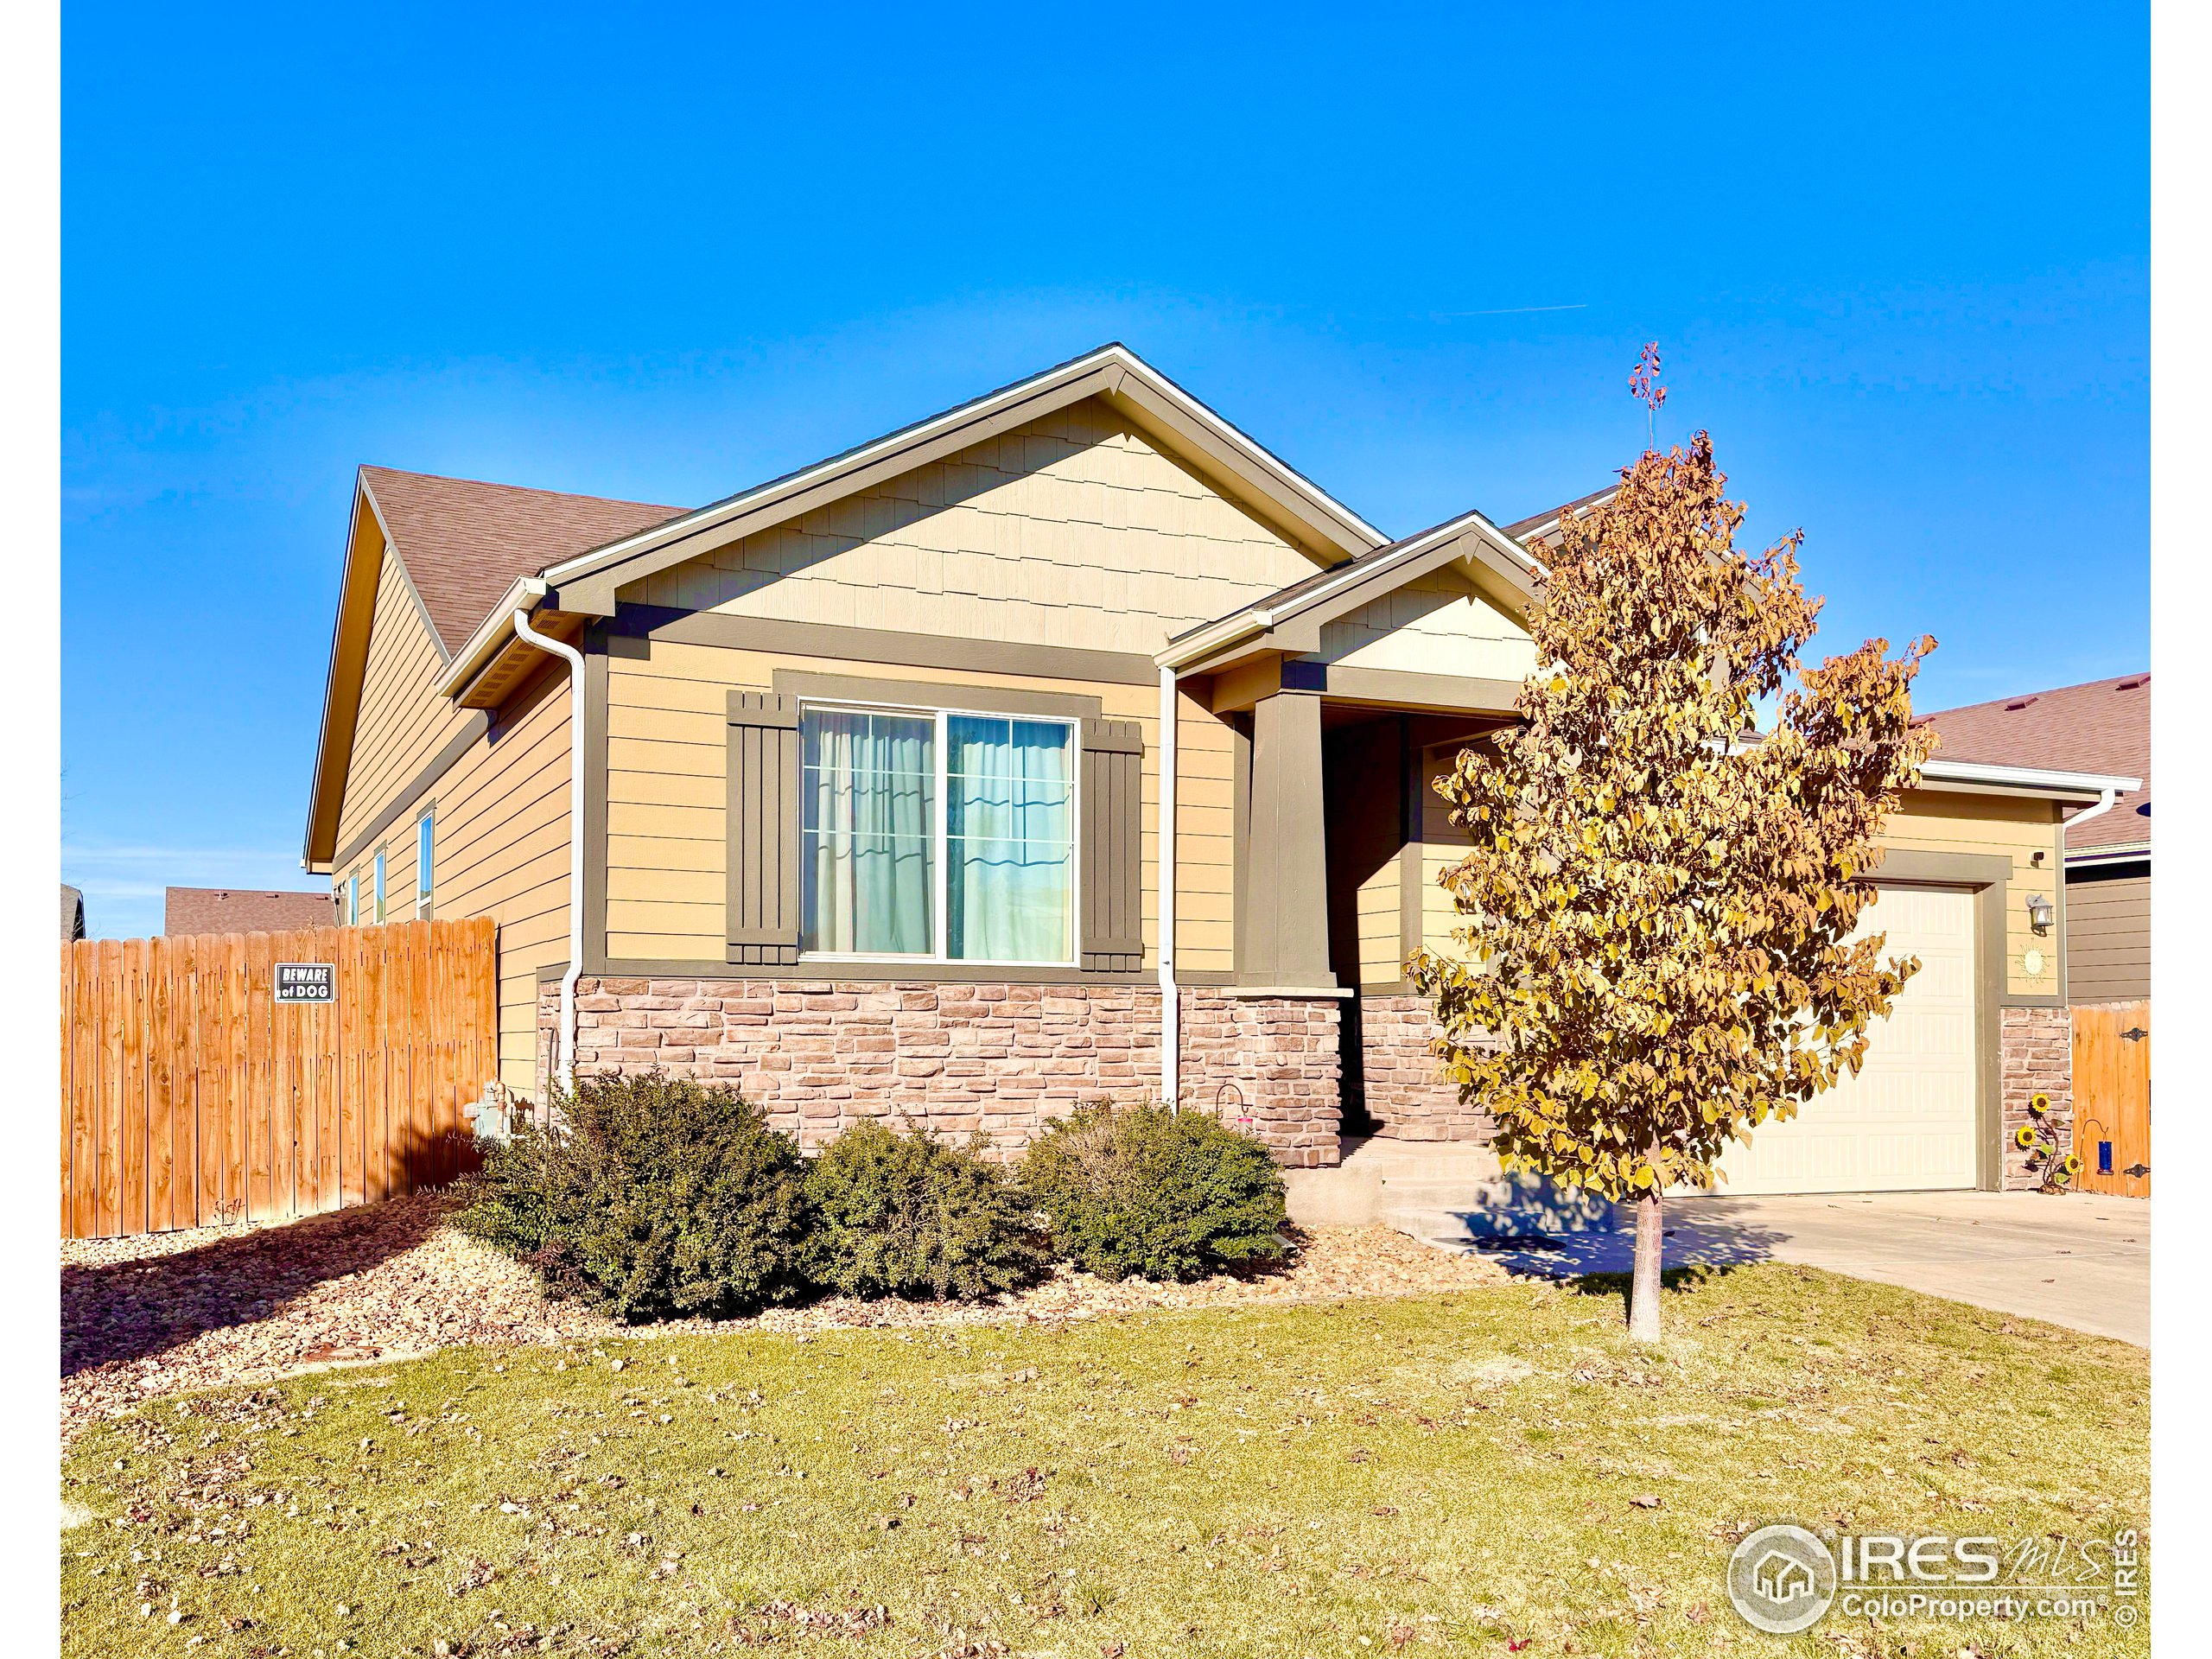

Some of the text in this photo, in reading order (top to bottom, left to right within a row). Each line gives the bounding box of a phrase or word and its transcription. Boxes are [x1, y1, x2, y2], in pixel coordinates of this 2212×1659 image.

[283, 968, 327, 982] BEWARE
[282, 984, 328, 998] of DOG
